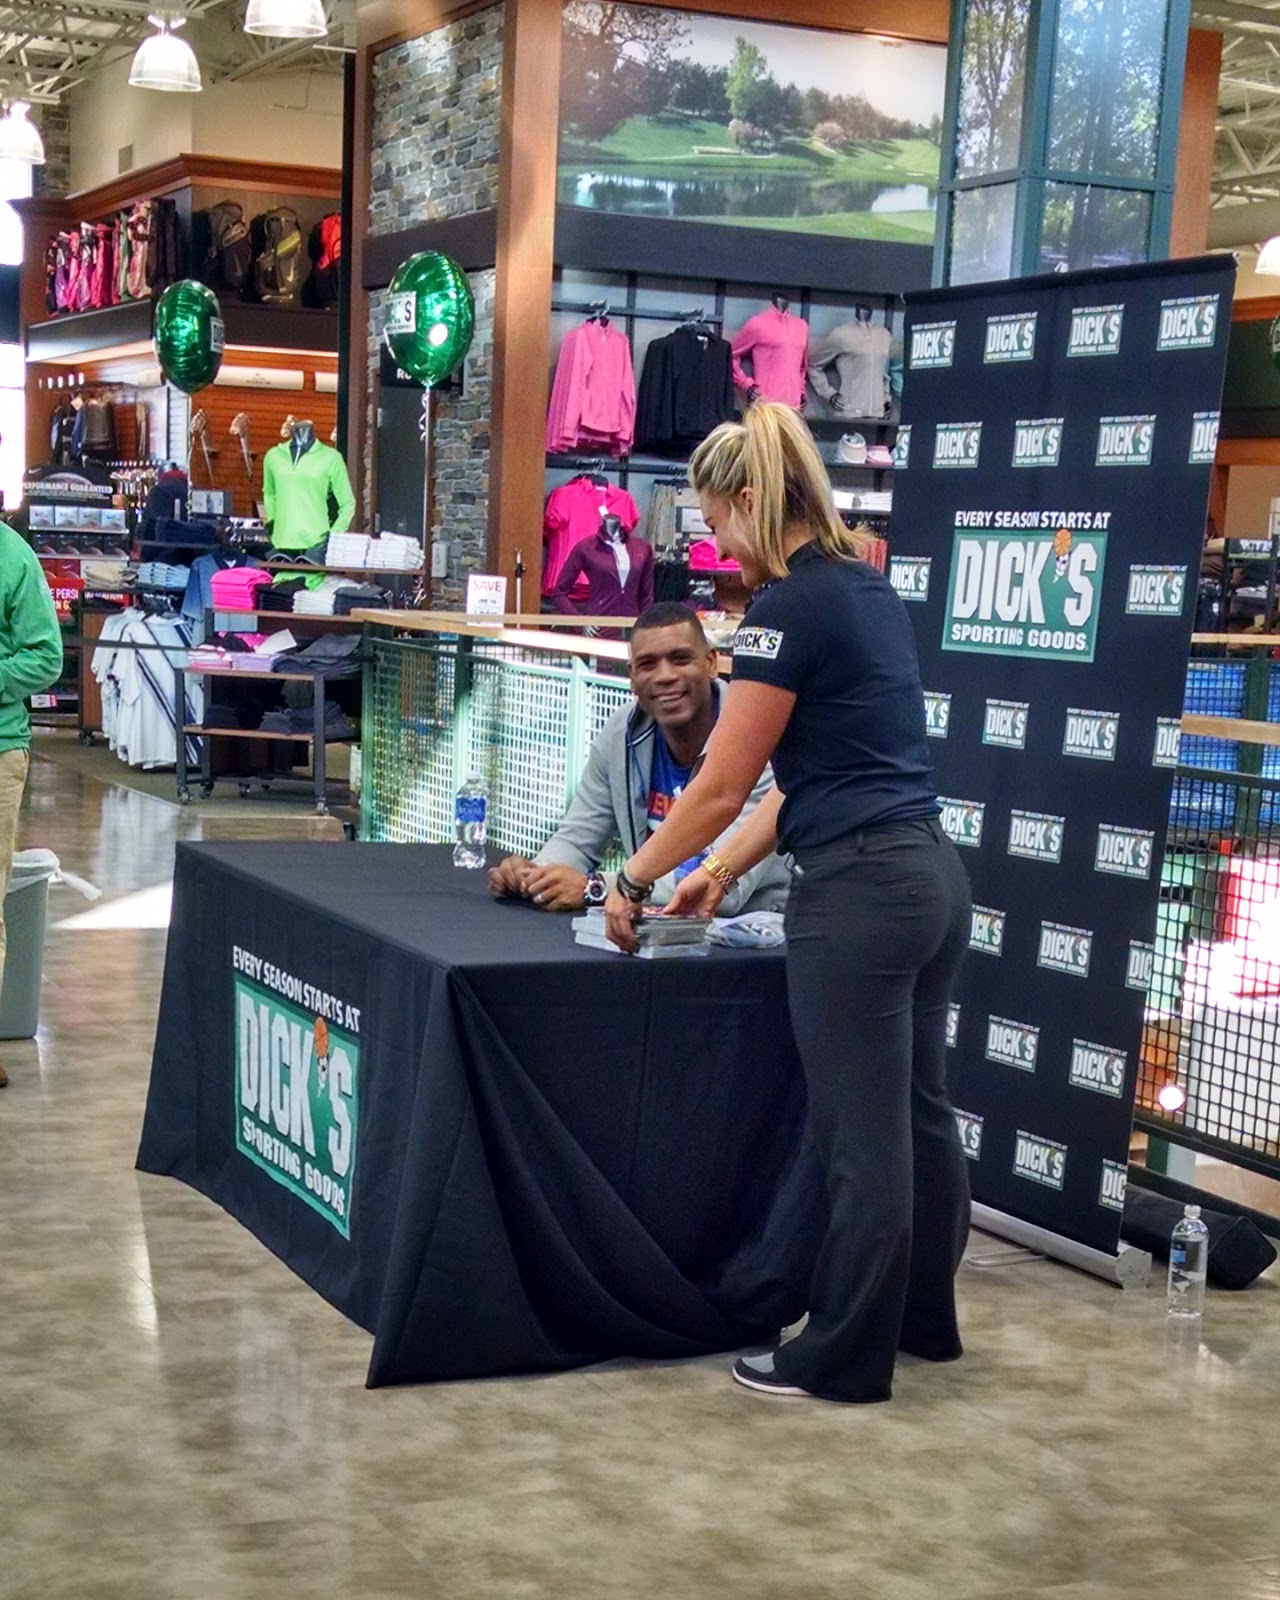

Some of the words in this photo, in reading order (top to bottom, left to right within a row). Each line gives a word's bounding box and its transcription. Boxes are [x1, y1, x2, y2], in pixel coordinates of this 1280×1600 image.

[987, 320, 1034, 352] DICK'S
[1071, 312, 1120, 346] DICK'S
[1161, 303, 1215, 339] DICK'S
[912, 329, 953, 359] DICK'S
[936, 429, 978, 458] DICK'S
[1016, 425, 1059, 456] DICK'S
[1100, 422, 1151, 454] DICK'S
[955, 510, 993, 527] EVERY
[995, 510, 1040, 528] SEASON
[1041, 512, 1092, 528] STARTS
[1093, 512, 1111, 529] AT
[473, 580, 501, 592] SAVE
[890, 562, 928, 591] DICK'S
[952, 530, 1098, 627] DICK'S
[1129, 572, 1183, 604] DICK'S
[734, 632, 778, 650] DICK'S
[951, 623, 1024, 646] SPORTING
[1028, 627, 1087, 651] GOODS
[986, 707, 1024, 738] DICK'S
[1066, 718, 1115, 749] DICK'S
[1011, 818, 1061, 852] DICK'S
[1098, 833, 1150, 868] DICK'S
[971, 912, 1002, 945] ICK'S
[1040, 930, 1089, 966] DICK'S
[233, 946, 262, 980] EVERY
[263, 962, 302, 1002] SEASON
[303, 982, 344, 1025] STARTS
[345, 1004, 360, 1032] AT
[988, 1024, 1036, 1061] DICK'S
[1072, 1048, 1123, 1086] DICK'S
[239, 990, 353, 1178] DICK'S
[243, 1117, 301, 1180] SPORTING
[305, 1162, 345, 1216] GOODS
[1016, 1138, 1064, 1178] DICK'S
